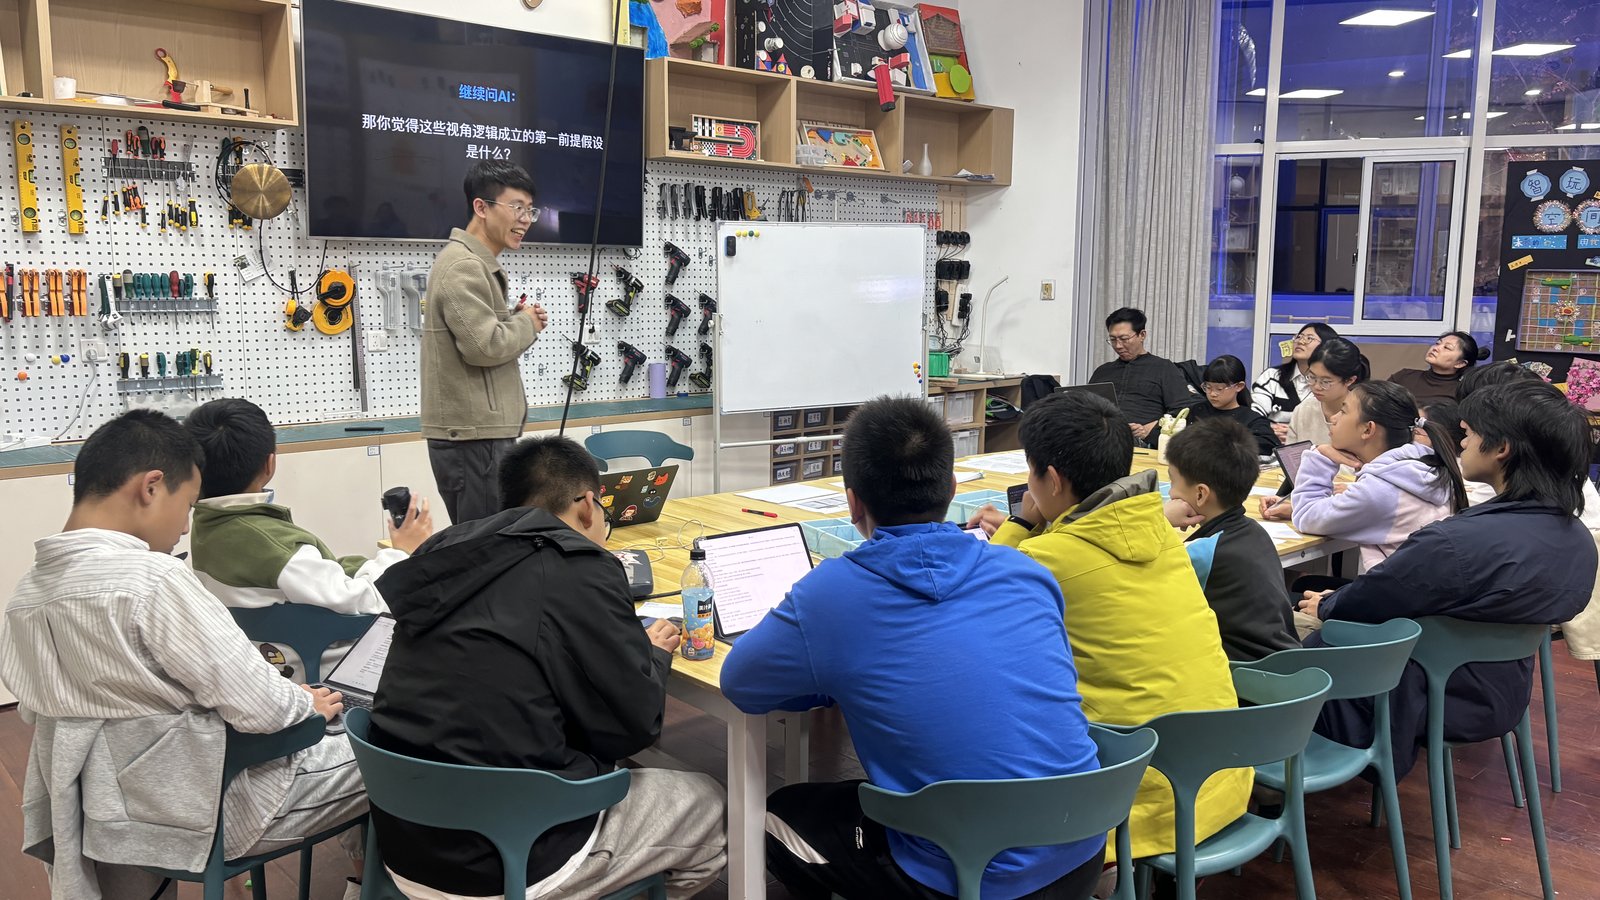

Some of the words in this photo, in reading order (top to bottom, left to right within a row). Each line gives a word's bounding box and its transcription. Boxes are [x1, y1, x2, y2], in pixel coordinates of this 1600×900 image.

[459, 84, 516, 103] 继续问AI:
[361, 113, 604, 150] 那你觉得这些视角逻辑成立的第一前提假设
[466, 144, 511, 160] 是什么?
